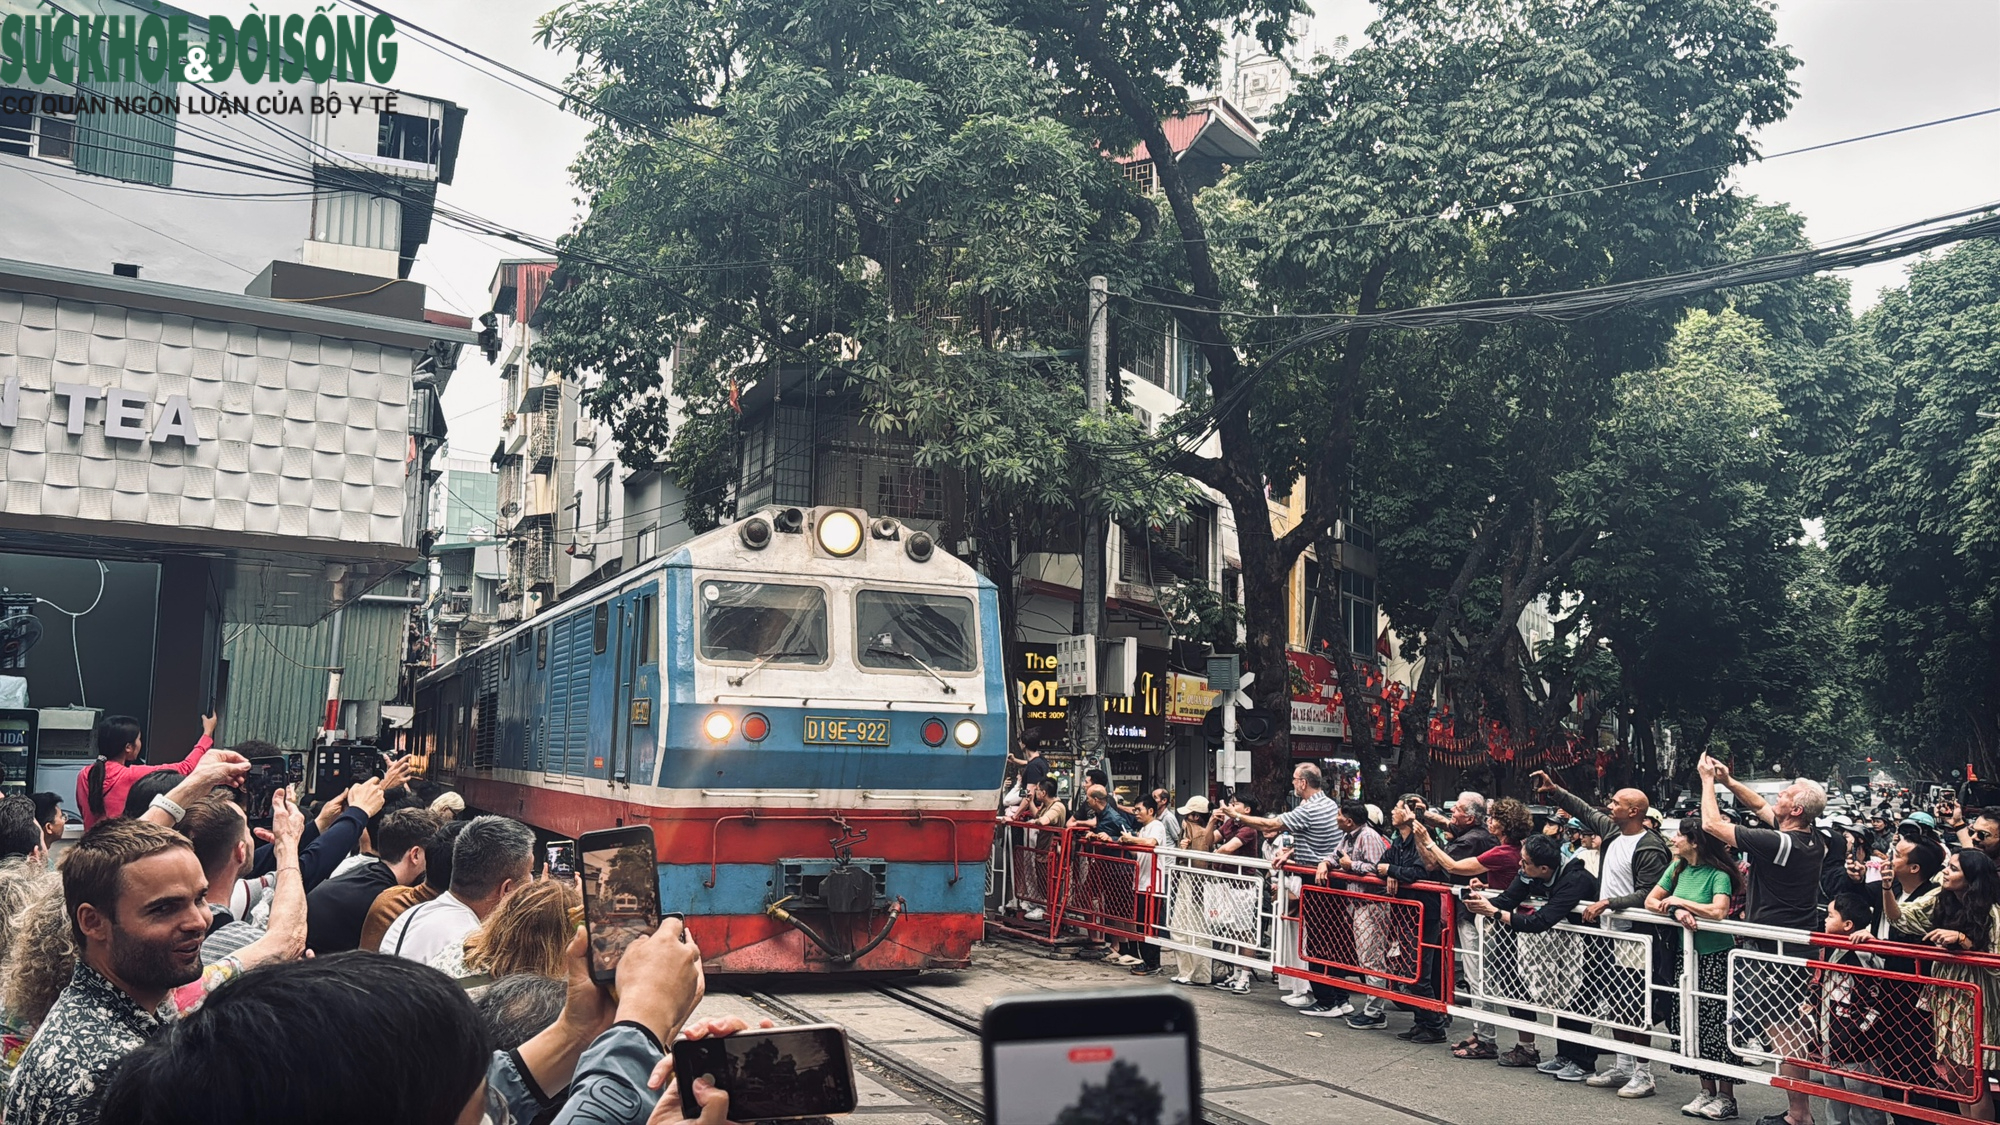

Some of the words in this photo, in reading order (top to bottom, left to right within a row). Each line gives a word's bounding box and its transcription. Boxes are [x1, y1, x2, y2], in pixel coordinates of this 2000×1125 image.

[54, 382, 200, 446] TEA
[1025, 652, 1057, 669] The
[1027, 711, 1047, 719] SINCE
[1048, 711, 1065, 719] 2009
[808, 720, 886, 742] D19E-922
